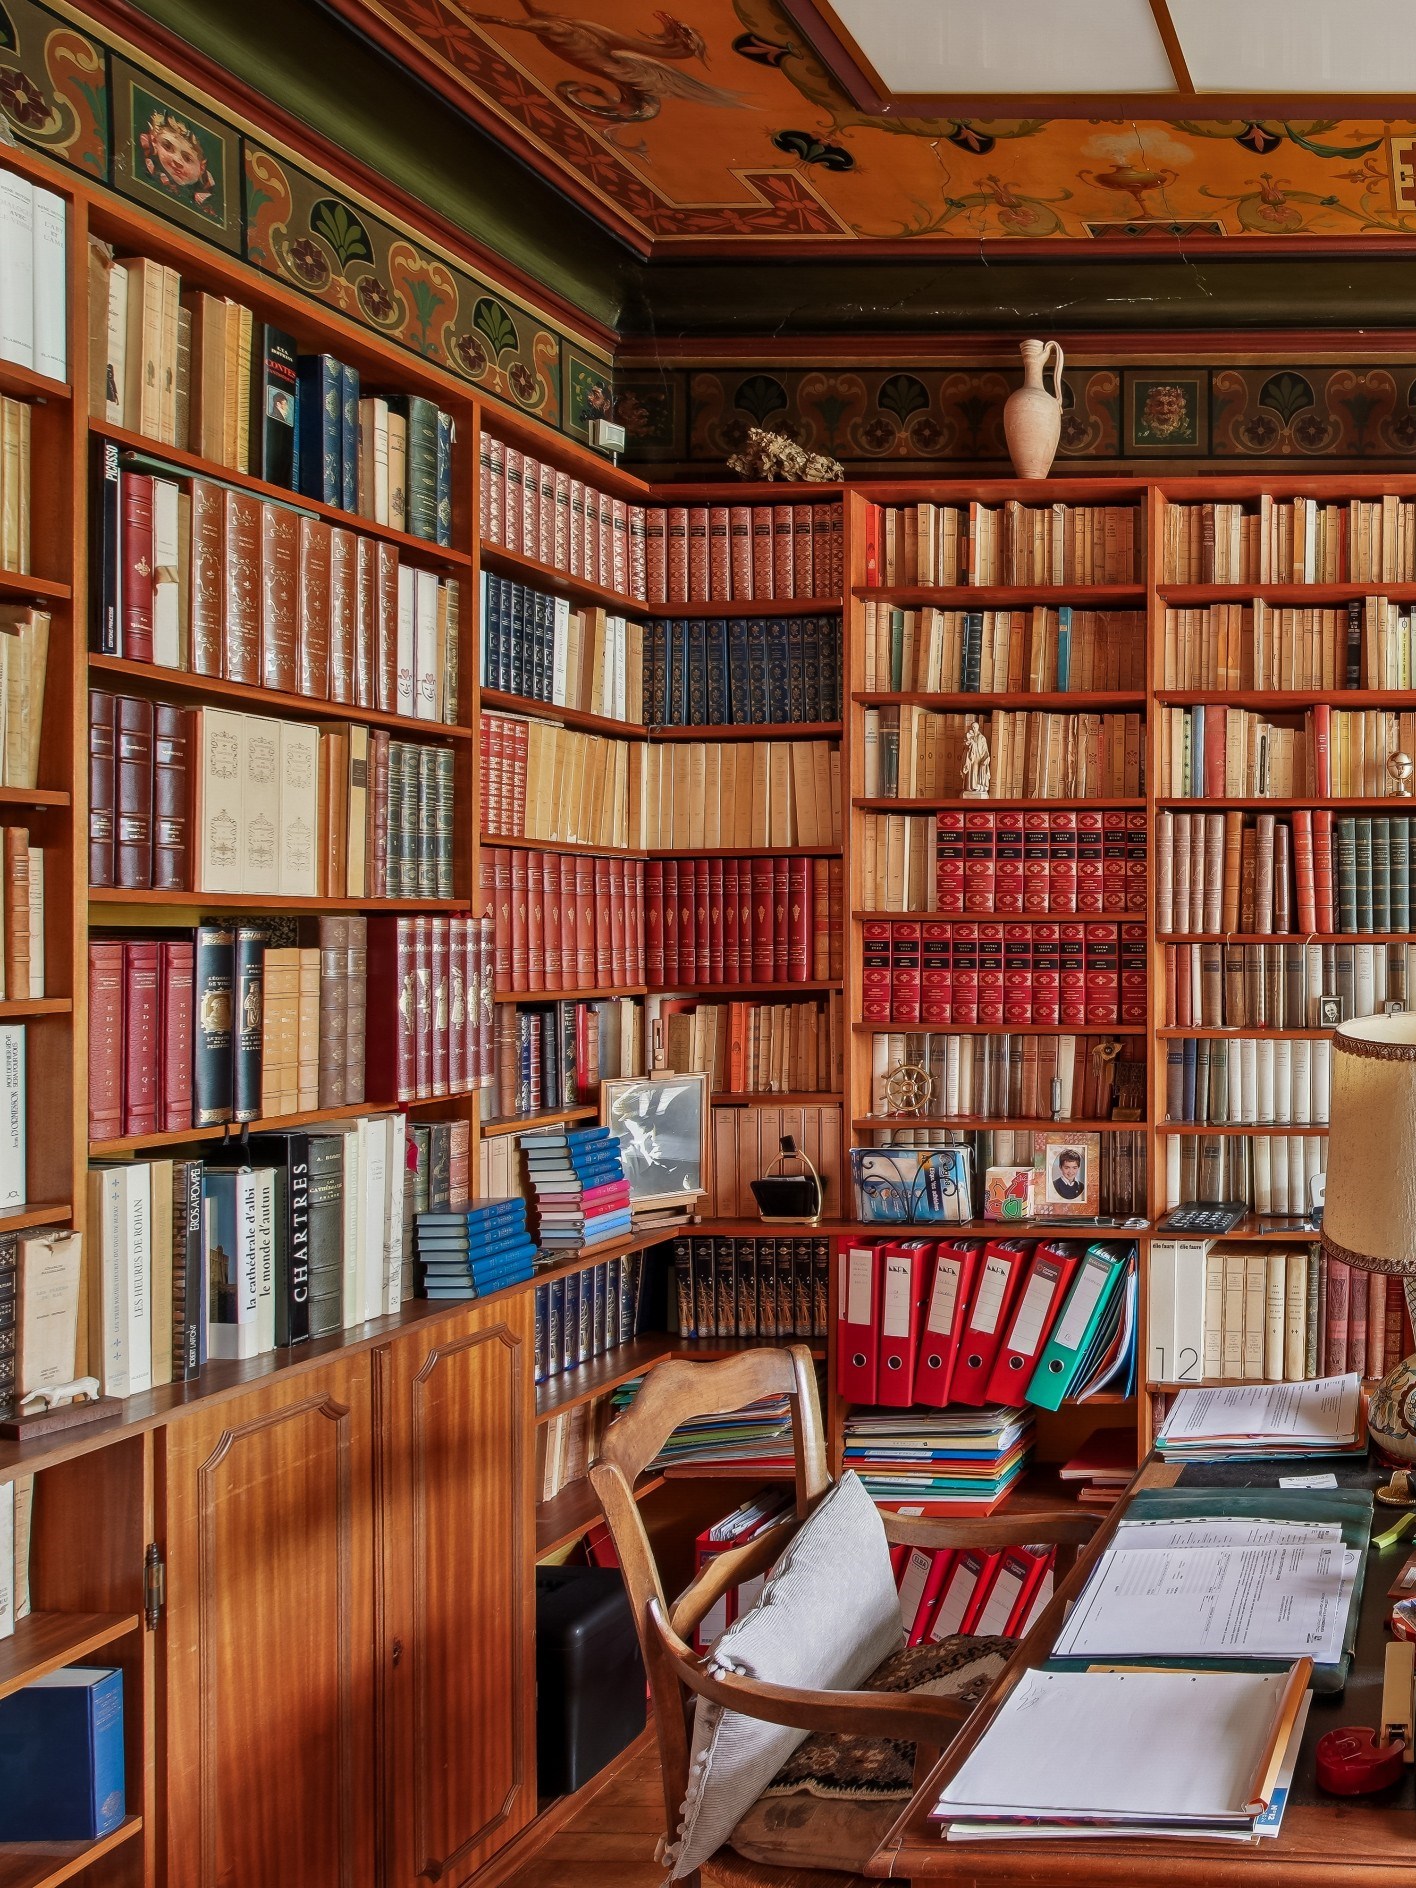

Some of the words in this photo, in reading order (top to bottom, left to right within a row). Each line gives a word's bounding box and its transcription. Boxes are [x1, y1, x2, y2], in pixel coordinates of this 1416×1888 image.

[265, 358, 296, 378] CONTES
[106, 444, 119, 481] PICASSO
[133, 1198, 143, 1236] ROHAN
[189, 1207, 200, 1231] EROS
[245, 1187, 255, 1223] d'albi
[258, 1187, 270, 1235] d'autun
[134, 1238, 143, 1254] DE
[293, 1163, 308, 1303] CHARTRES
[245, 1227, 256, 1293] cathédrale
[259, 1239, 271, 1281] monde
[134, 1256, 143, 1297] HEURES
[259, 1285, 271, 1297] le
[135, 1298, 144, 1318] LES
[246, 1298, 256, 1310] la
[1155, 1347, 1165, 1380] 1
[1178, 1348, 1198, 1380] 2
[914, 1555, 928, 1569] ELBA
[1268, 1805, 1278, 1820] N°12
